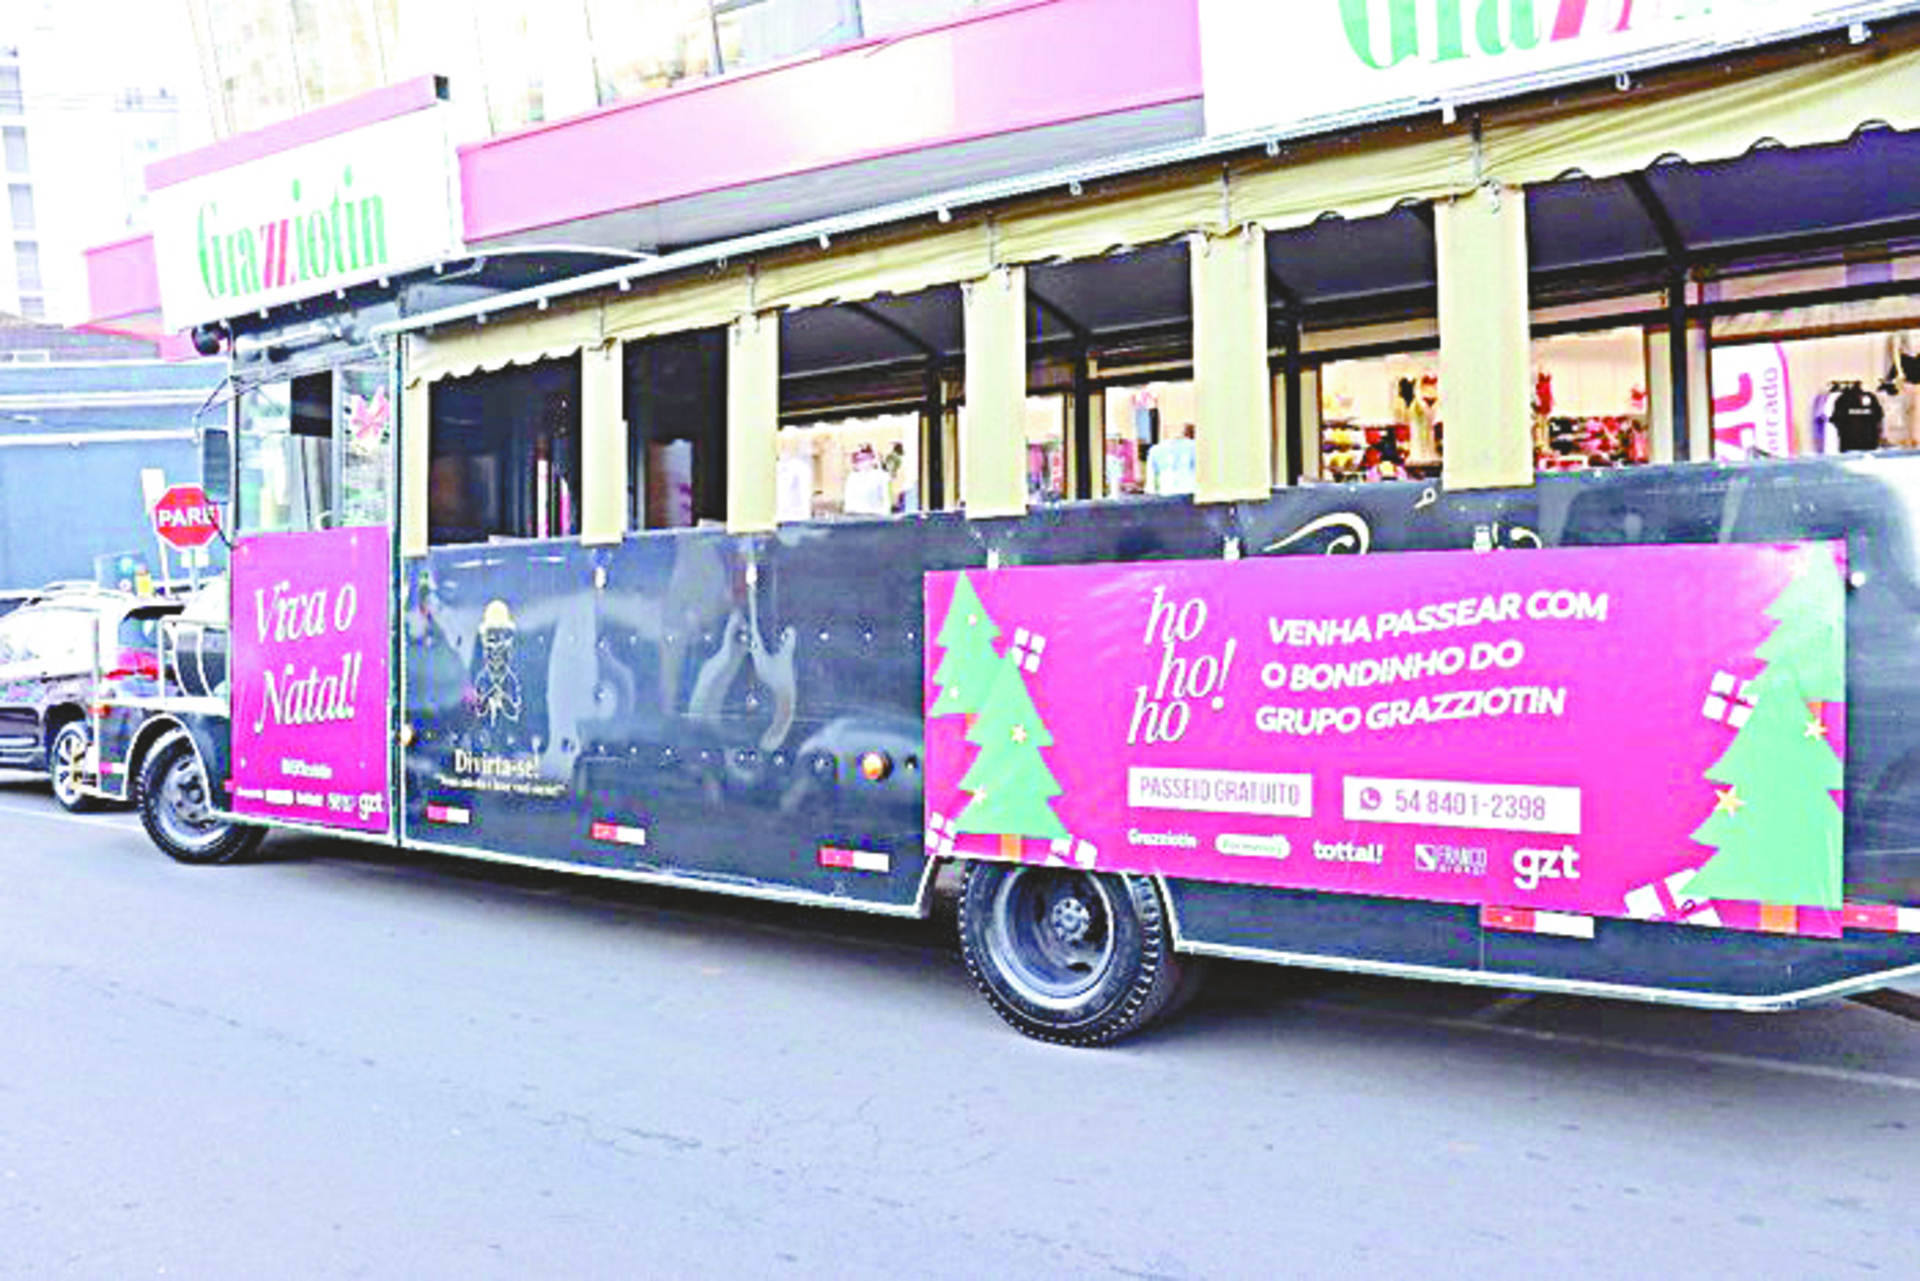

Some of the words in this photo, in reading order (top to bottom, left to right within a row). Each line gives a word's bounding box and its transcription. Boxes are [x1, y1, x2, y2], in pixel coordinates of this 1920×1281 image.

[197, 163, 387, 299] Grazziotin
[254, 581, 326, 643] Viva
[334, 583, 357, 632] o
[1143, 585, 1207, 645] ho
[1268, 617, 1371, 647] VENHA
[1376, 592, 1522, 639] PASSEAR
[1525, 589, 1608, 623] COM
[253, 651, 362, 734] Natal!
[1154, 637, 1236, 710] ho!
[1262, 662, 1286, 688] O
[1290, 646, 1464, 691] BONDINHO
[1470, 640, 1524, 673] DO
[1127, 685, 1190, 745] ho
[1255, 705, 1361, 736] GRUPO
[1365, 687, 1566, 730] GRAZZIOTIN
[1140, 776, 1210, 801] PASSEIO
[1215, 779, 1300, 807] GRATUITO
[1396, 789, 1420, 813] 54
[1427, 790, 1545, 820] 8401-2398
[1513, 845, 1580, 890] gzt
